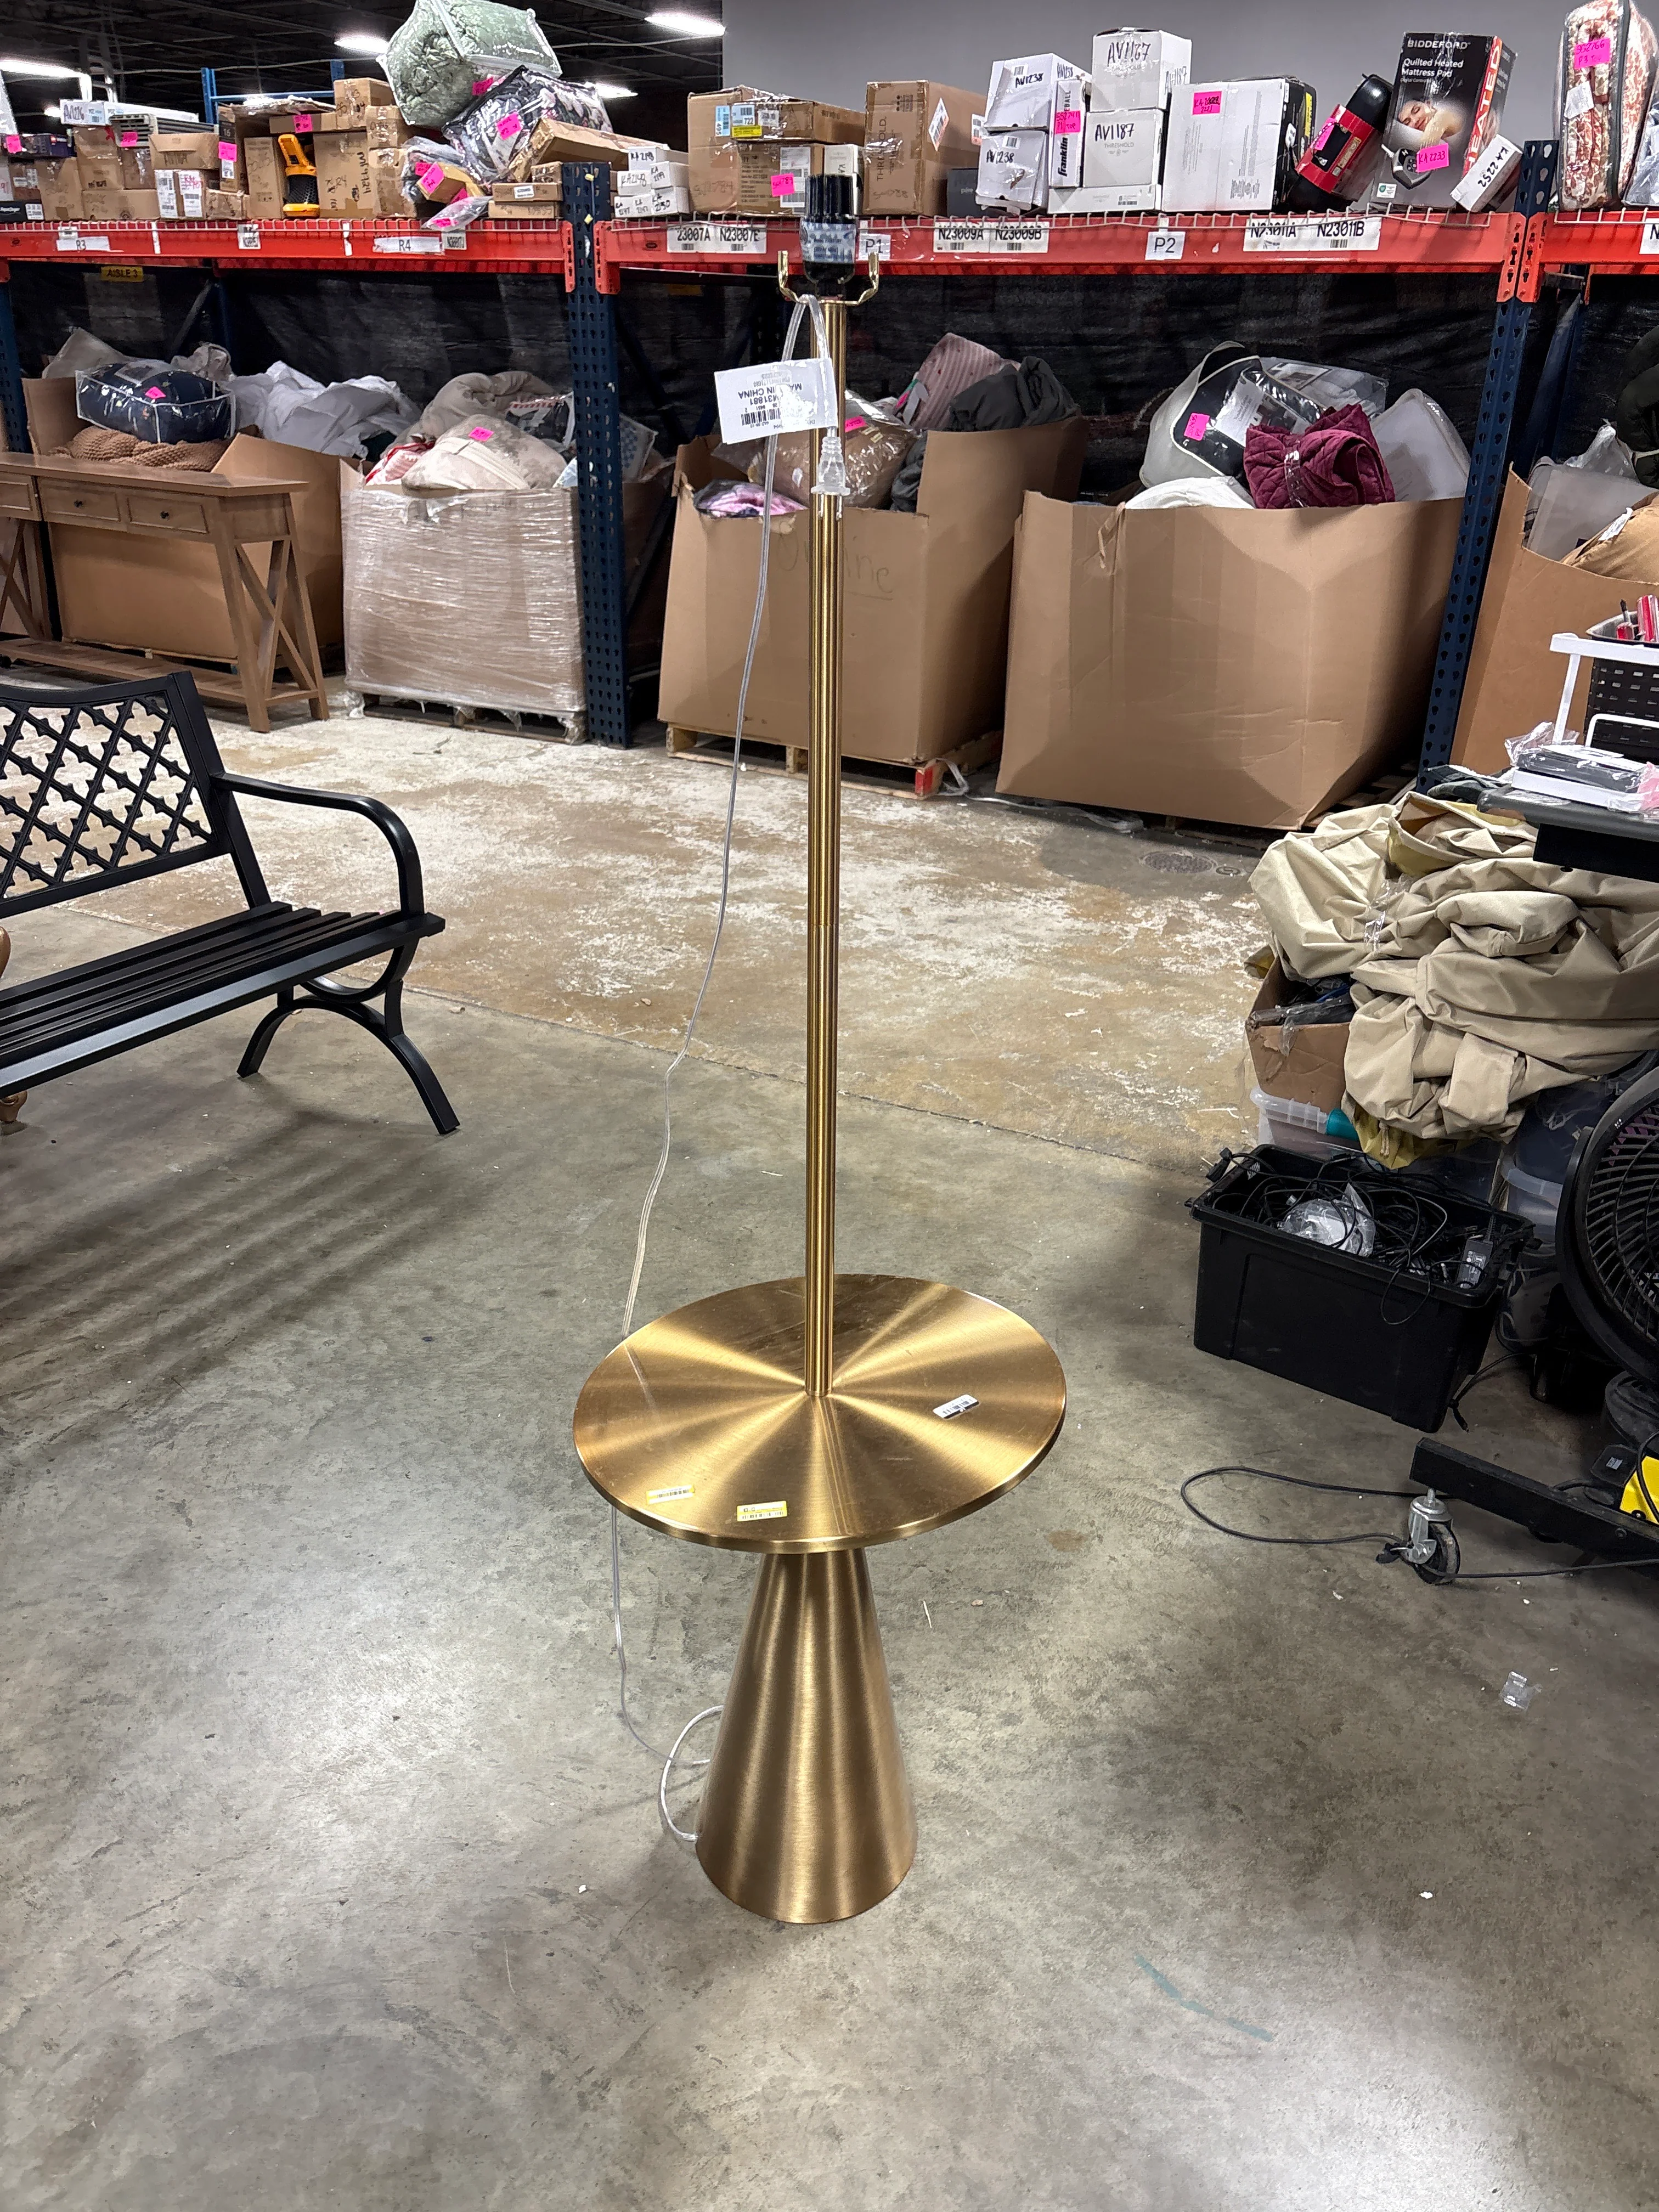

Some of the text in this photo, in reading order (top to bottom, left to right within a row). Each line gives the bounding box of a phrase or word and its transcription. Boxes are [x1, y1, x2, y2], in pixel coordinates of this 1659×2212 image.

[1404, 58, 1464, 68] Quilted Heated
[1095, 123, 1135, 142] AV1187
[1317, 221, 1365, 238] N23011B
[399, 239, 411, 251] R4
[865, 238, 883, 254] P1
[1154, 238, 1176, 253] P2
[738, 388, 764, 399] CHINA
